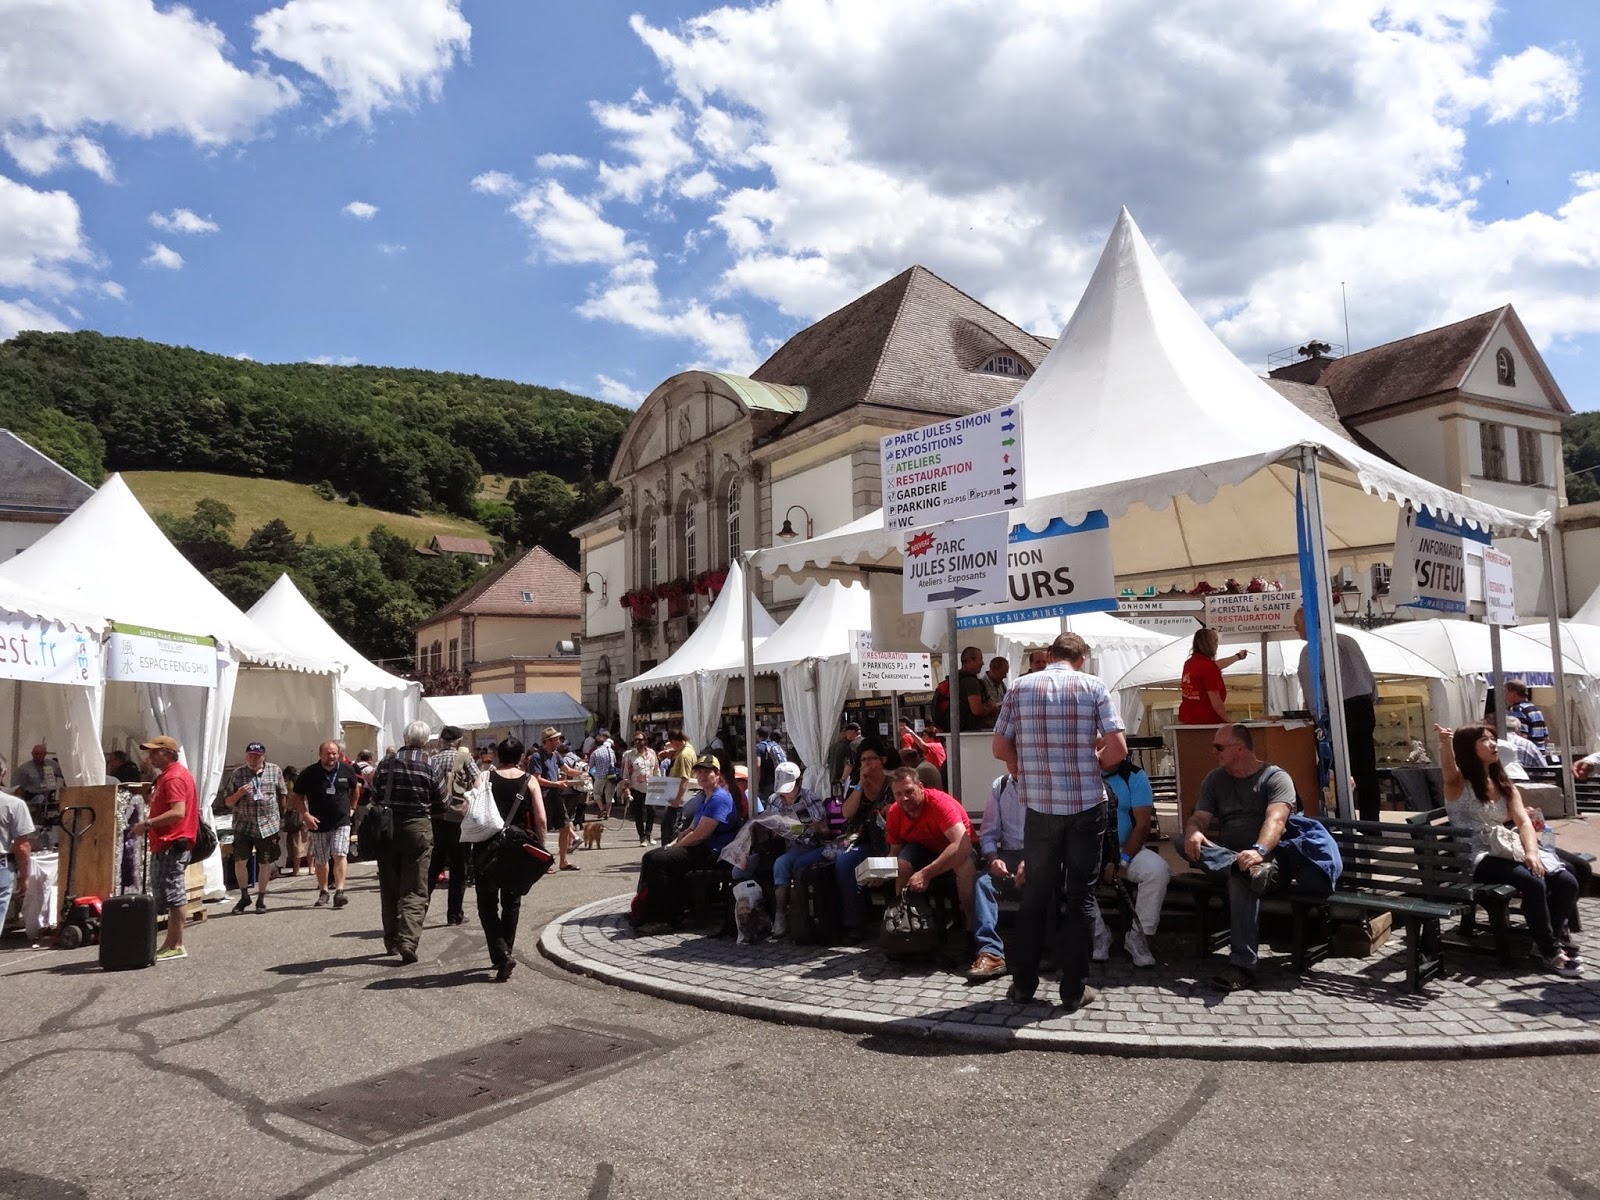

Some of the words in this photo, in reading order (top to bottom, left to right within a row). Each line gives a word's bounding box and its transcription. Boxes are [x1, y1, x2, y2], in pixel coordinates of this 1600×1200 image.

[895, 431, 919, 446] PARC
[922, 423, 952, 441] JULES
[955, 413, 991, 431] SIMON
[895, 434, 963, 459] EXPOSITIONS
[896, 454, 941, 473] ATELIERS
[896, 461, 973, 487] RESTAURATION
[897, 481, 947, 500] GARDERIE
[897, 496, 941, 514] PARKING
[943, 495, 966, 505] P12-P16
[976, 488, 1001, 498] P17-P18
[898, 516, 914, 528] WC
[936, 538, 965, 556] PARC
[1419, 538, 1463, 560] INFORMATIO
[909, 558, 945, 579] JULES
[948, 550, 997, 572] SIMON
[1008, 549, 1043, 567] TION
[918, 578, 943, 588] Ateliers
[947, 571, 986, 584] Exposants
[1008, 567, 1075, 601] URS
[1217, 595, 1253, 604] THEATRE
[1262, 592, 1296, 601] PISCINE
[957, 607, 1065, 627] TE-MARIE-AUX-MINES
[1217, 605, 1251, 614] CRISTAL
[1254, 604, 1259, 612] &
[1263, 603, 1291, 611] SANTE
[1217, 613, 1281, 623] RESTAURATION
[1218, 625, 1235, 633] ZONE
[0, 631, 56, 667] est.fr
[867, 652, 908, 660] RESTAURATION
[140, 656, 168, 671] ESPACE
[169, 660, 190, 673] FENG
[192, 662, 209, 675] SHUI
[868, 681, 878, 689] WC
